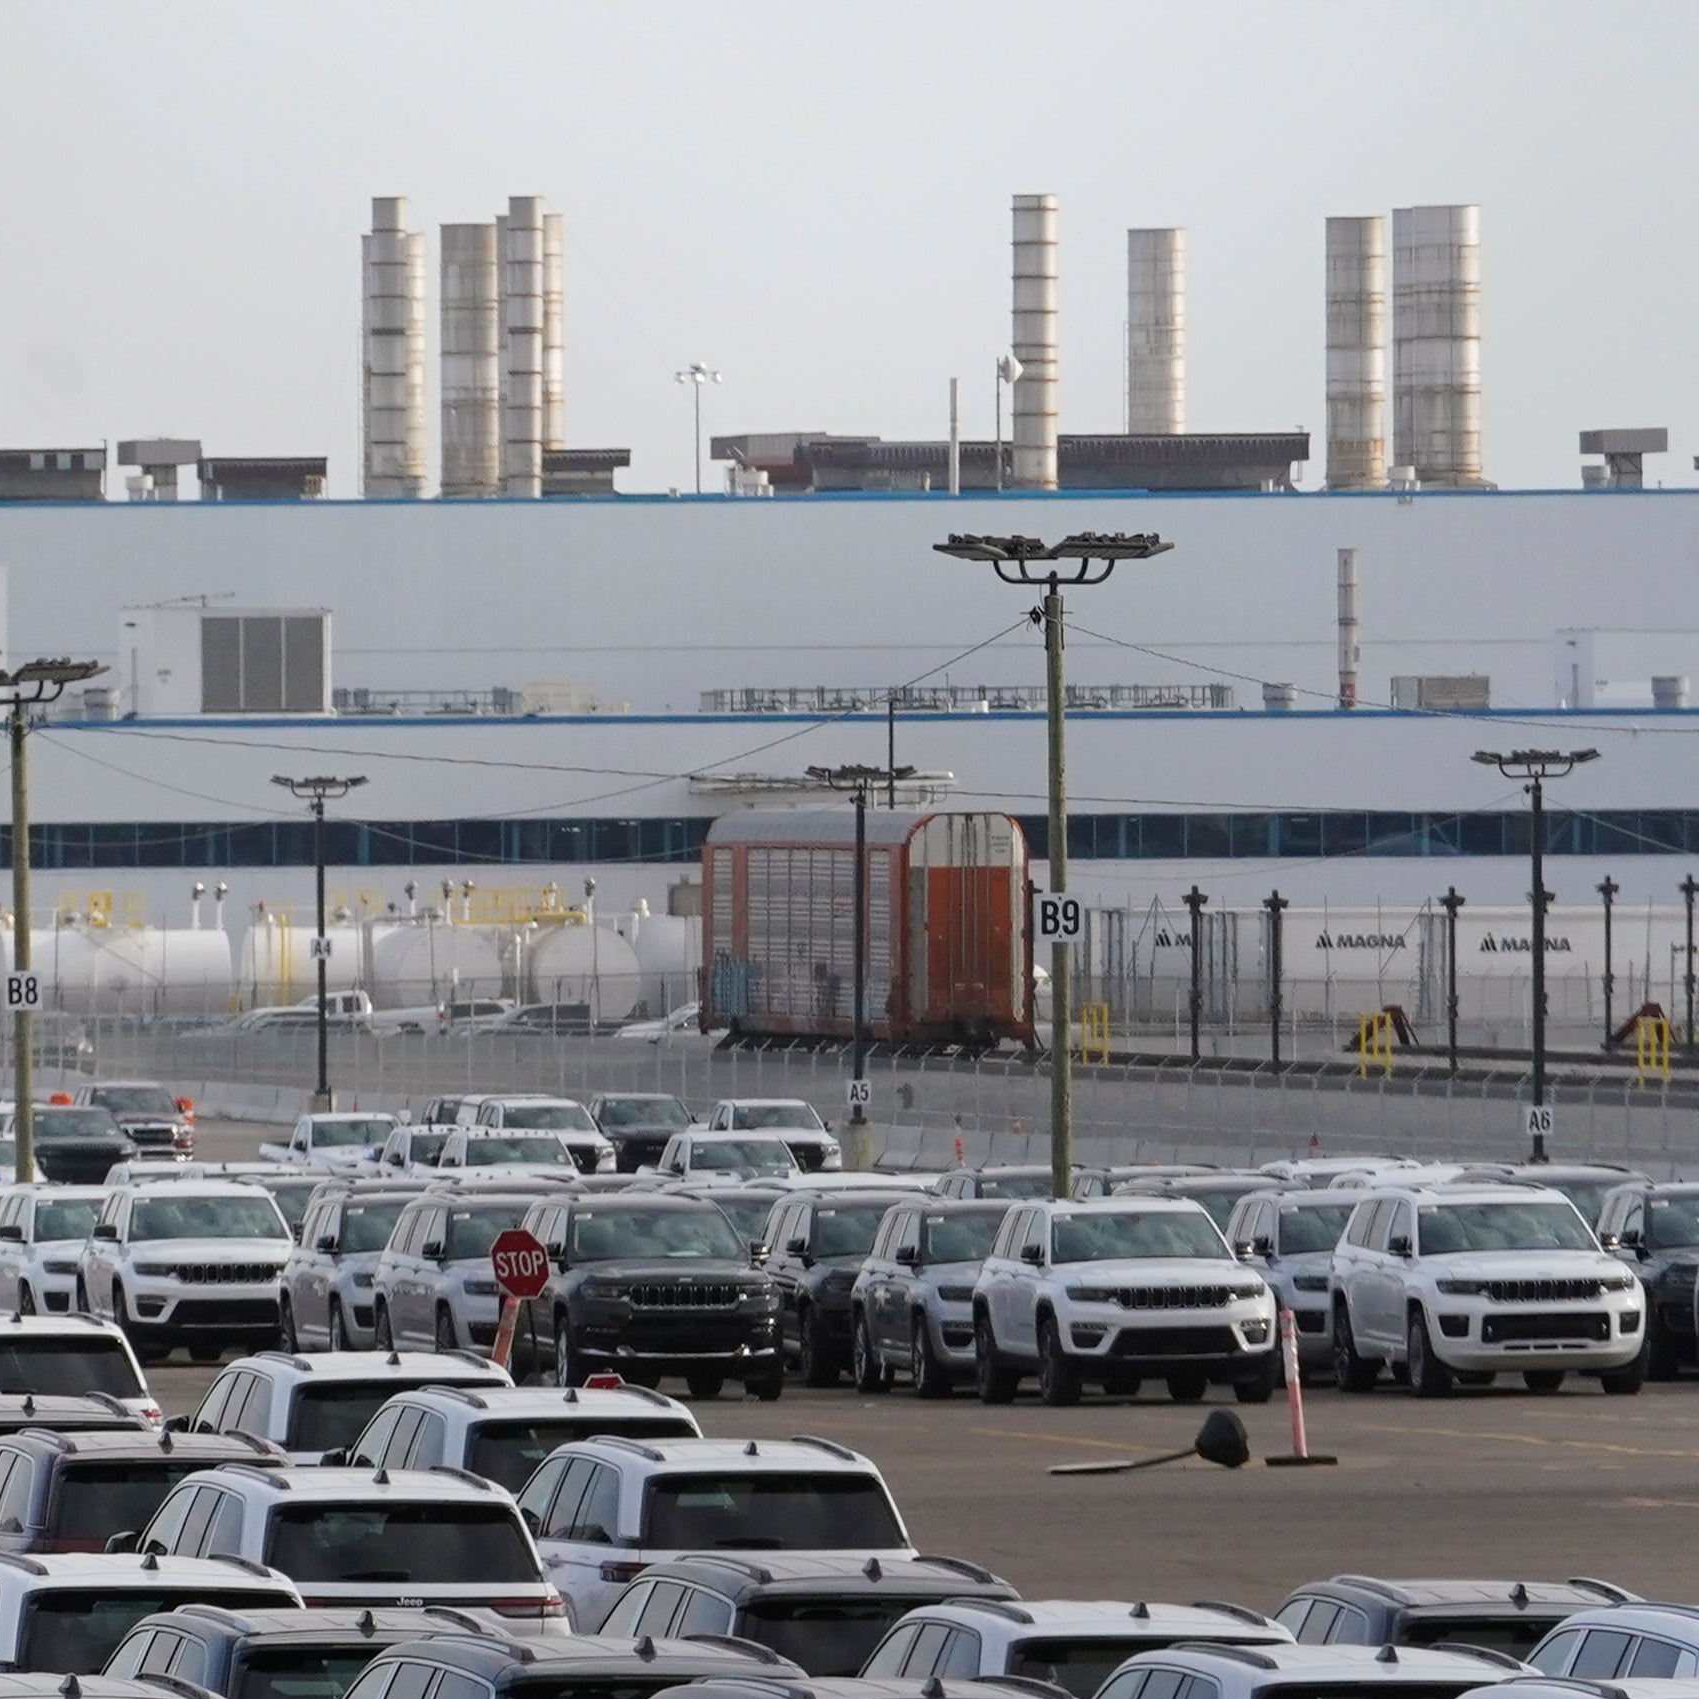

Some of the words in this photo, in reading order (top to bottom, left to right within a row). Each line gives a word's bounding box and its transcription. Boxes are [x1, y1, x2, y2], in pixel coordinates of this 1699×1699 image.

[1041, 900, 1079, 935] B9
[314, 941, 331, 955] A4
[1336, 933, 1405, 947] MAGNA
[1501, 936, 1570, 951] MANA
[8, 977, 37, 1004] B8
[850, 1084, 868, 1101] A5
[1529, 1111, 1550, 1130] A6
[495, 1250, 545, 1278] STOP
[396, 1597, 423, 1607] Jeep
